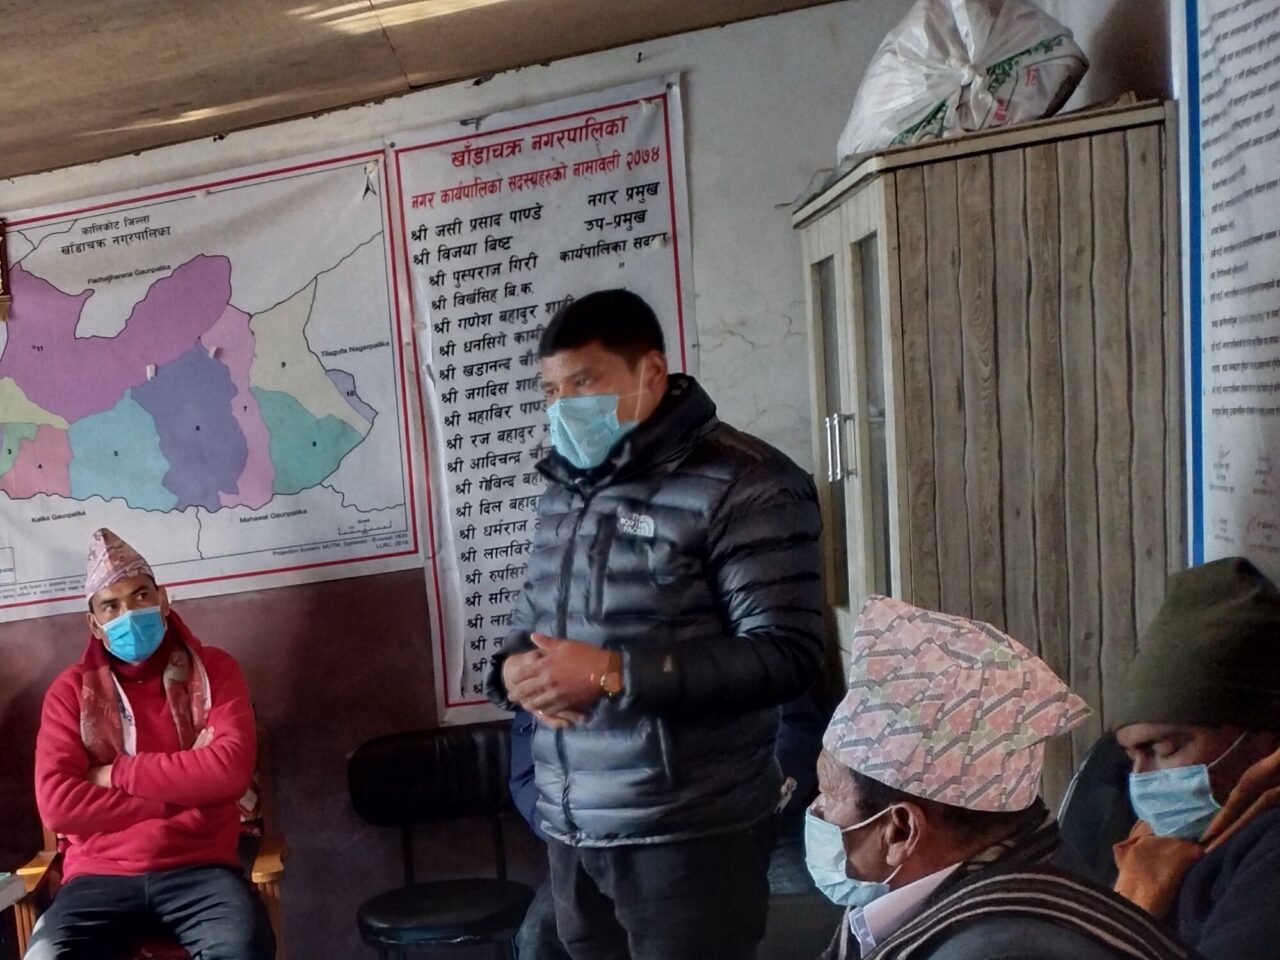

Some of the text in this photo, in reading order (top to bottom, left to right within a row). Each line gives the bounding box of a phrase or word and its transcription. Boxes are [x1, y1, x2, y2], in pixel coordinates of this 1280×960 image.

[531, 116, 628, 150] नगरपालिका
[411, 191, 436, 209] नगर
[440, 177, 503, 204] कार्यपालिका
[573, 149, 621, 176] नामावली
[626, 146, 660, 171] २०७४
[588, 181, 660, 207] नगर प्रमुख
[81, 215, 151, 235] कालिकोट जिल्ला
[411, 202, 544, 242] श्री जसी प्रसाद पाण्डे
[584, 209, 648, 231] उप-प्रमुख
[112, 226, 171, 246] नगरपालिका
[413, 234, 514, 265] श्री विजया बिष्ट
[560, 239, 627, 262] कार्यपालिका
[429, 269, 446, 287] श्री
[509, 251, 538, 273] गिरी
[431, 295, 448, 311] श्री
[434, 317, 451, 334] श्री
[457, 312, 493, 330] गणेश
[499, 304, 538, 325] बहादुर
[439, 340, 456, 357] श्री
[439, 363, 456, 381] श्री
[441, 387, 458, 404] श्री
[465, 380, 509, 400] जगदिस
[444, 410, 461, 427] श्री
[468, 403, 513, 425] महाविर
[446, 433, 464, 450] श्री
[470, 432, 491, 448] रज
[497, 425, 536, 444] बहादुर
[447, 456, 464, 473] श्री
[455, 478, 472, 495] श्री
[479, 474, 516, 491] गोविन्द
[456, 501, 473, 518] श्री
[479, 498, 503, 515] दिल
[460, 524, 476, 540] श्री
[483, 519, 528, 537] धर्मराज
[461, 546, 477, 563] श्री
[465, 568, 482, 585] श्री
[465, 591, 482, 607] श्री
[467, 613, 484, 629] श्री
[470, 635, 487, 651] श्री
[472, 657, 487, 672] श्री
